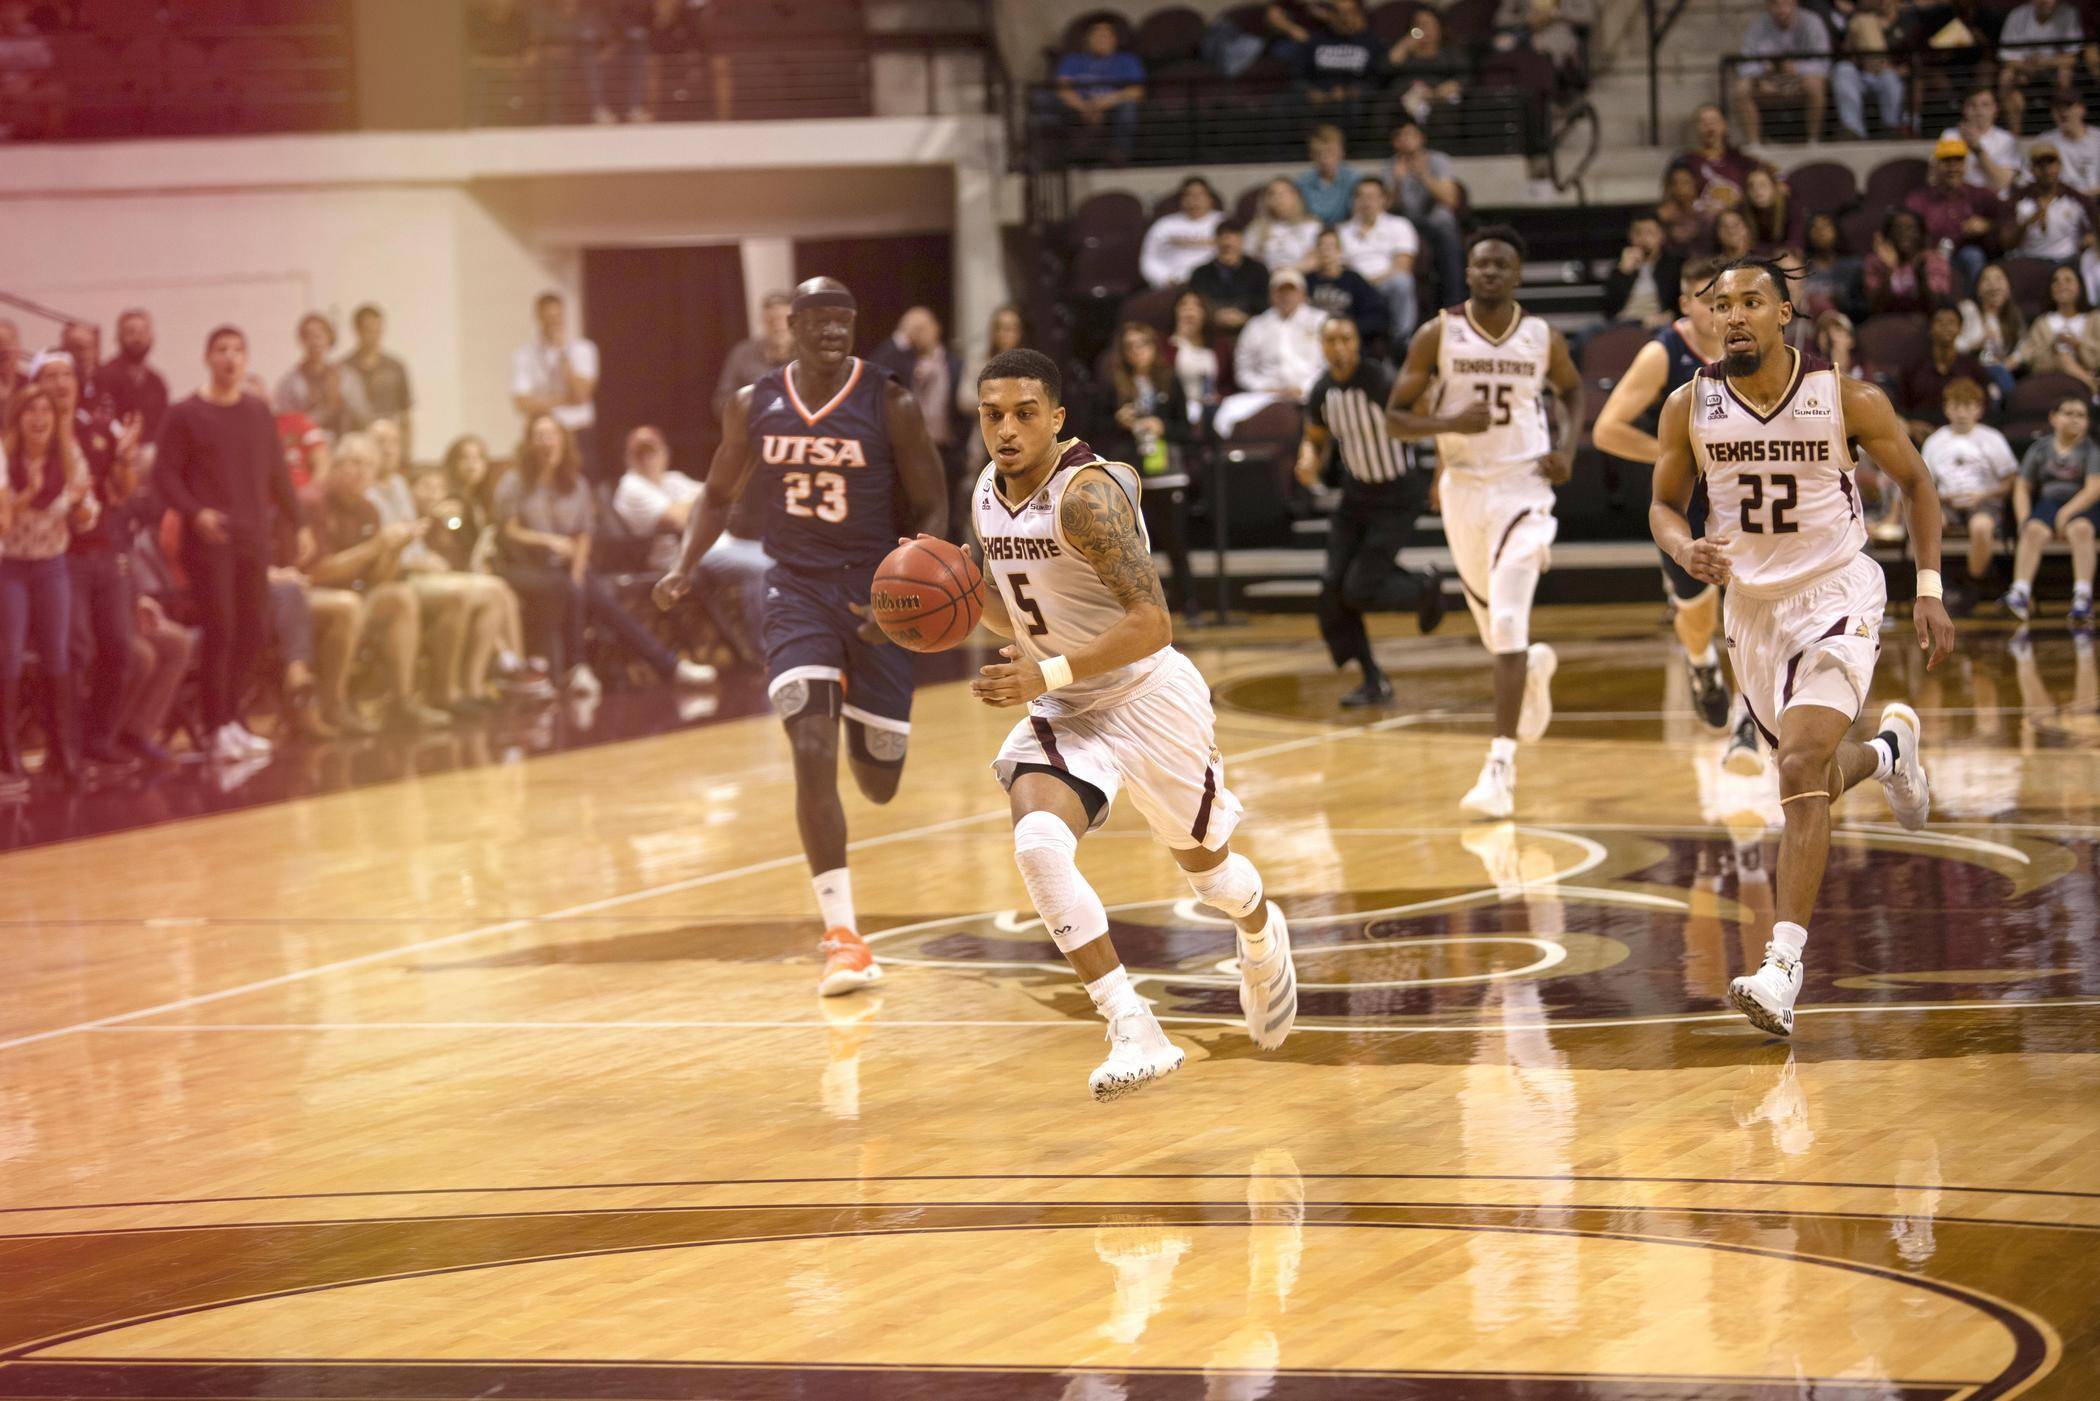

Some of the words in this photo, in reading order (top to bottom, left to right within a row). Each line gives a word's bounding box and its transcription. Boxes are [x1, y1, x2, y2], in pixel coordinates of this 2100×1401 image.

[762, 434, 866, 467] UTSA
[1705, 440, 1766, 462] TEXAS
[1768, 440, 1829, 462] STATE
[782, 470, 849, 524] 23
[1738, 473, 1799, 534] 22
[1014, 536, 1062, 560] STATE
[1007, 573, 1048, 636] 5
